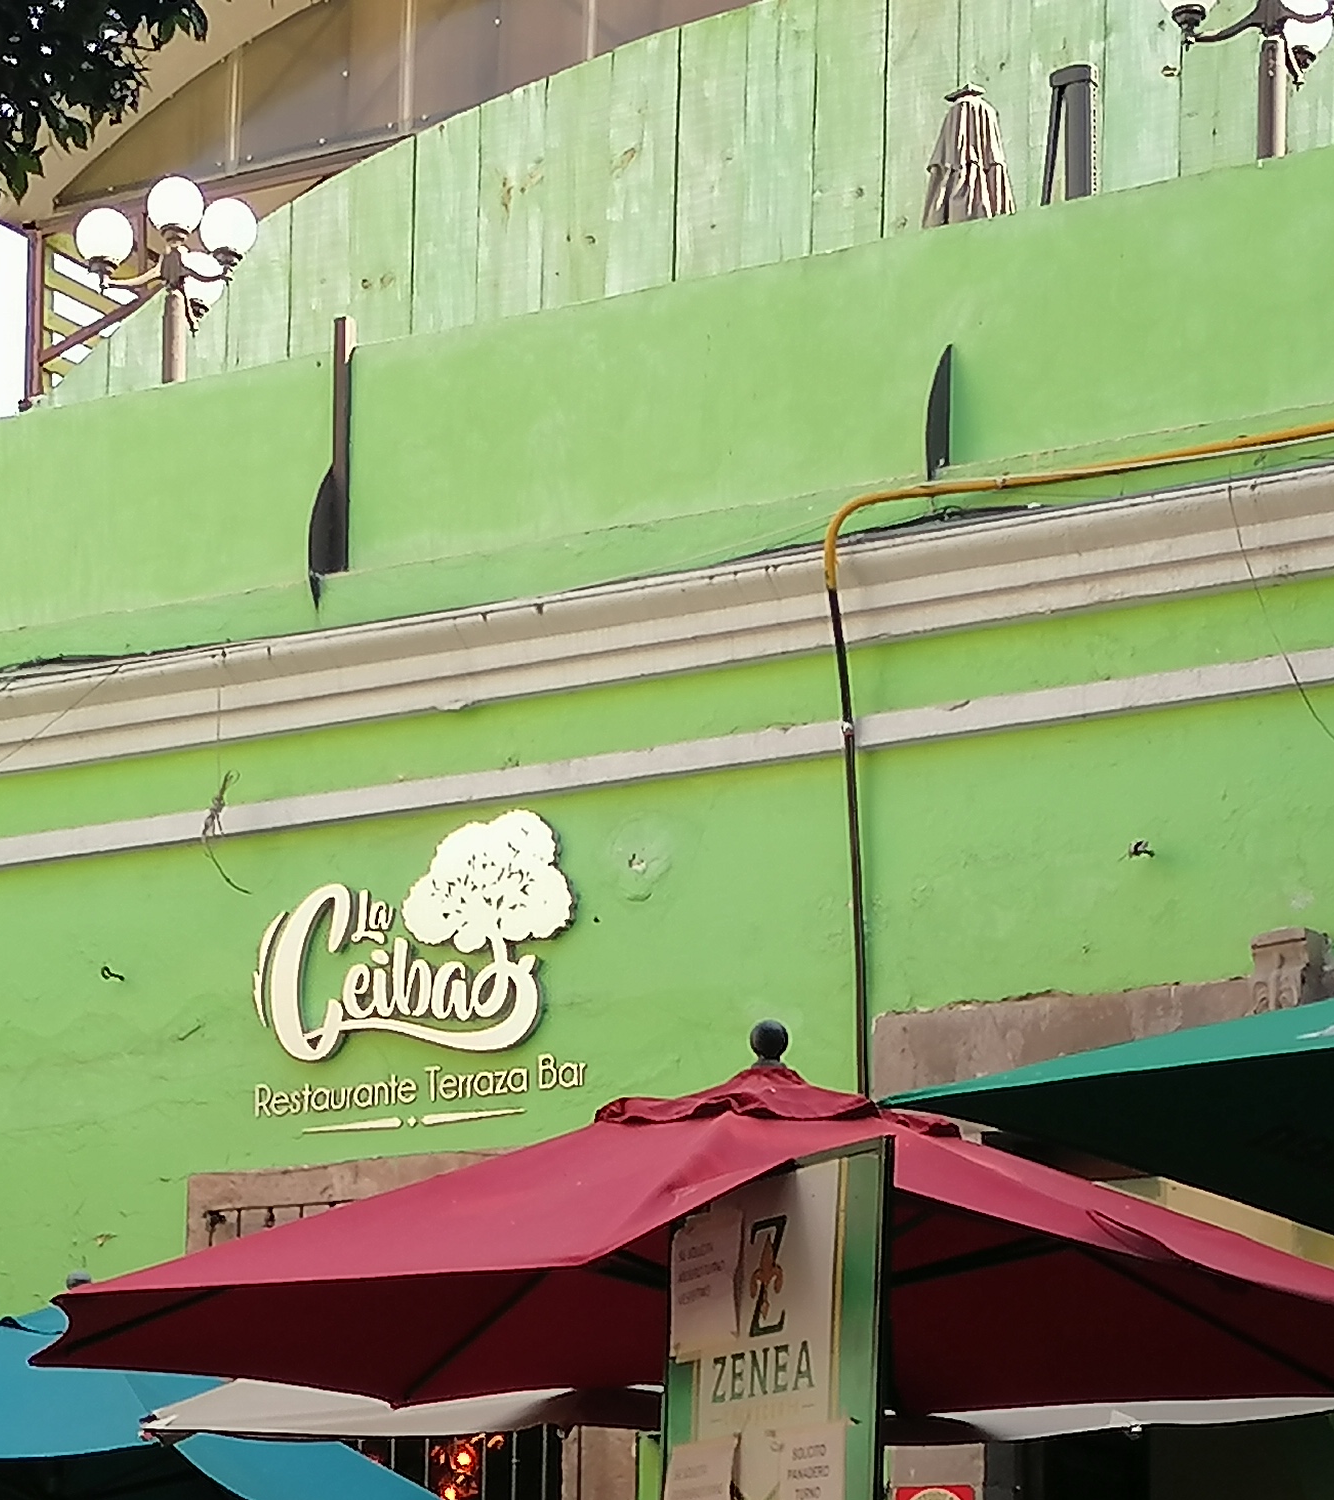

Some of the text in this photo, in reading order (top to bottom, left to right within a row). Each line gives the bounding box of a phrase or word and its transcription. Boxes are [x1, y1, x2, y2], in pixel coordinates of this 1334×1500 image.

[352, 890, 394, 944] La
[254, 882, 541, 1063] Ceiba
[253, 1053, 587, 1118] Restaurante Terraza Bar
[712, 1340, 816, 1403] ZENEA
